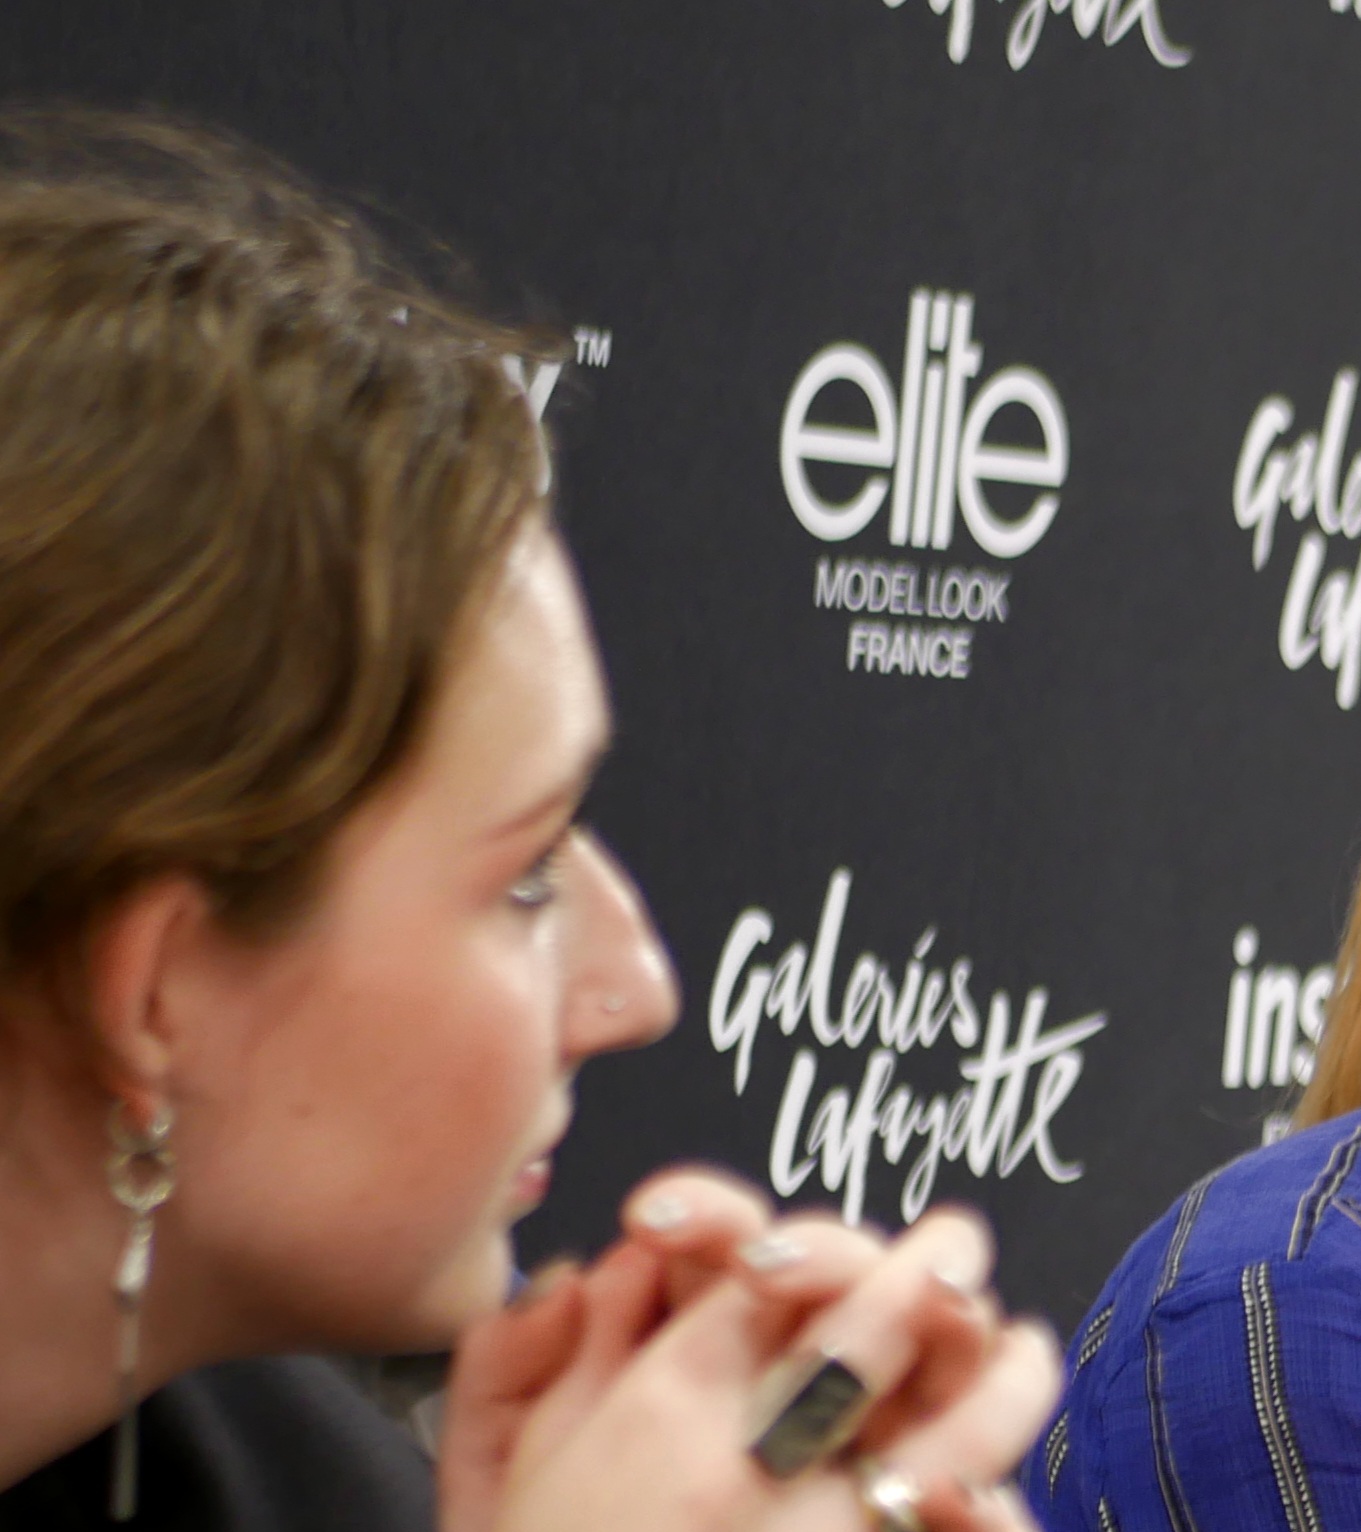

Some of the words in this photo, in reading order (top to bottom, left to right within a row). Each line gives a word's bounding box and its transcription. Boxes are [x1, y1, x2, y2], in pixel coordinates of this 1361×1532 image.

[780, 284, 1071, 559] elite
[814, 557, 924, 617] MODEL
[927, 566, 1010, 623] LOOK
[847, 622, 974, 679] FRANCE
[709, 867, 981, 1094] Galeries
[769, 988, 1108, 1226] Lafayette
